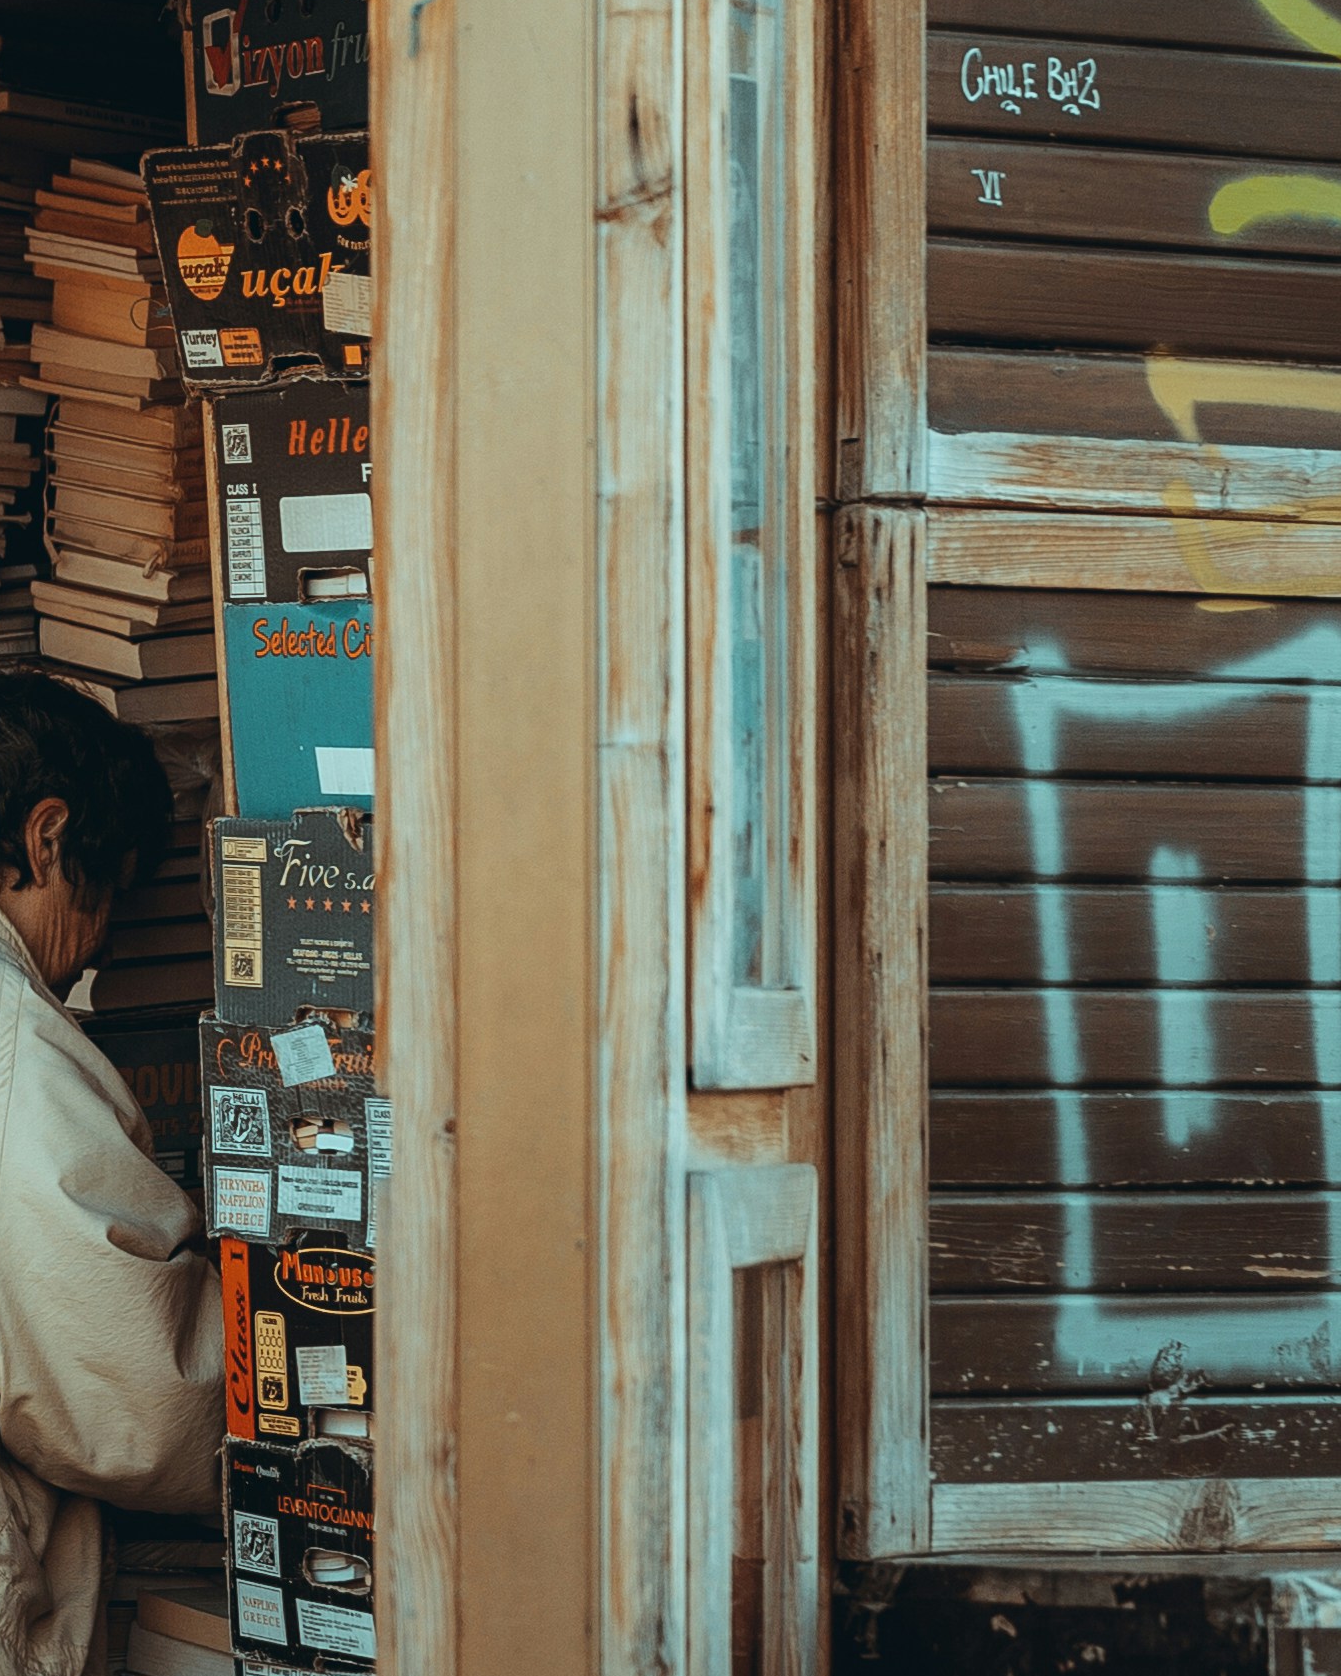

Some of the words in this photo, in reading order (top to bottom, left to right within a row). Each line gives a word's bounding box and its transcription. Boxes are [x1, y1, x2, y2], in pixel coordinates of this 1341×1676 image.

[326, 21, 370, 82] fru
[961, 48, 1038, 102] CHILE
[182, 329, 218, 348] Turkey
[288, 416, 369, 456] Helle
[227, 484, 249, 495] CLASS
[252, 618, 337, 658] Selected
[343, 619, 373, 658] Ci
[274, 839, 340, 889] Five
[219, 1177, 266, 1194] TIRYNTHA
[219, 1194, 266, 1209] NAFPLION
[219, 1212, 266, 1228] GREECE
[282, 1250, 375, 1289] Manouso
[300, 1285, 329, 1302] Fresh
[333, 1287, 368, 1305] Fruits
[230, 1283, 250, 1415] Class
[278, 1495, 374, 1530] LEVENTOGIANNI
[242, 1596, 279, 1613] NAFPLION
[243, 1612, 281, 1629] GREECE
